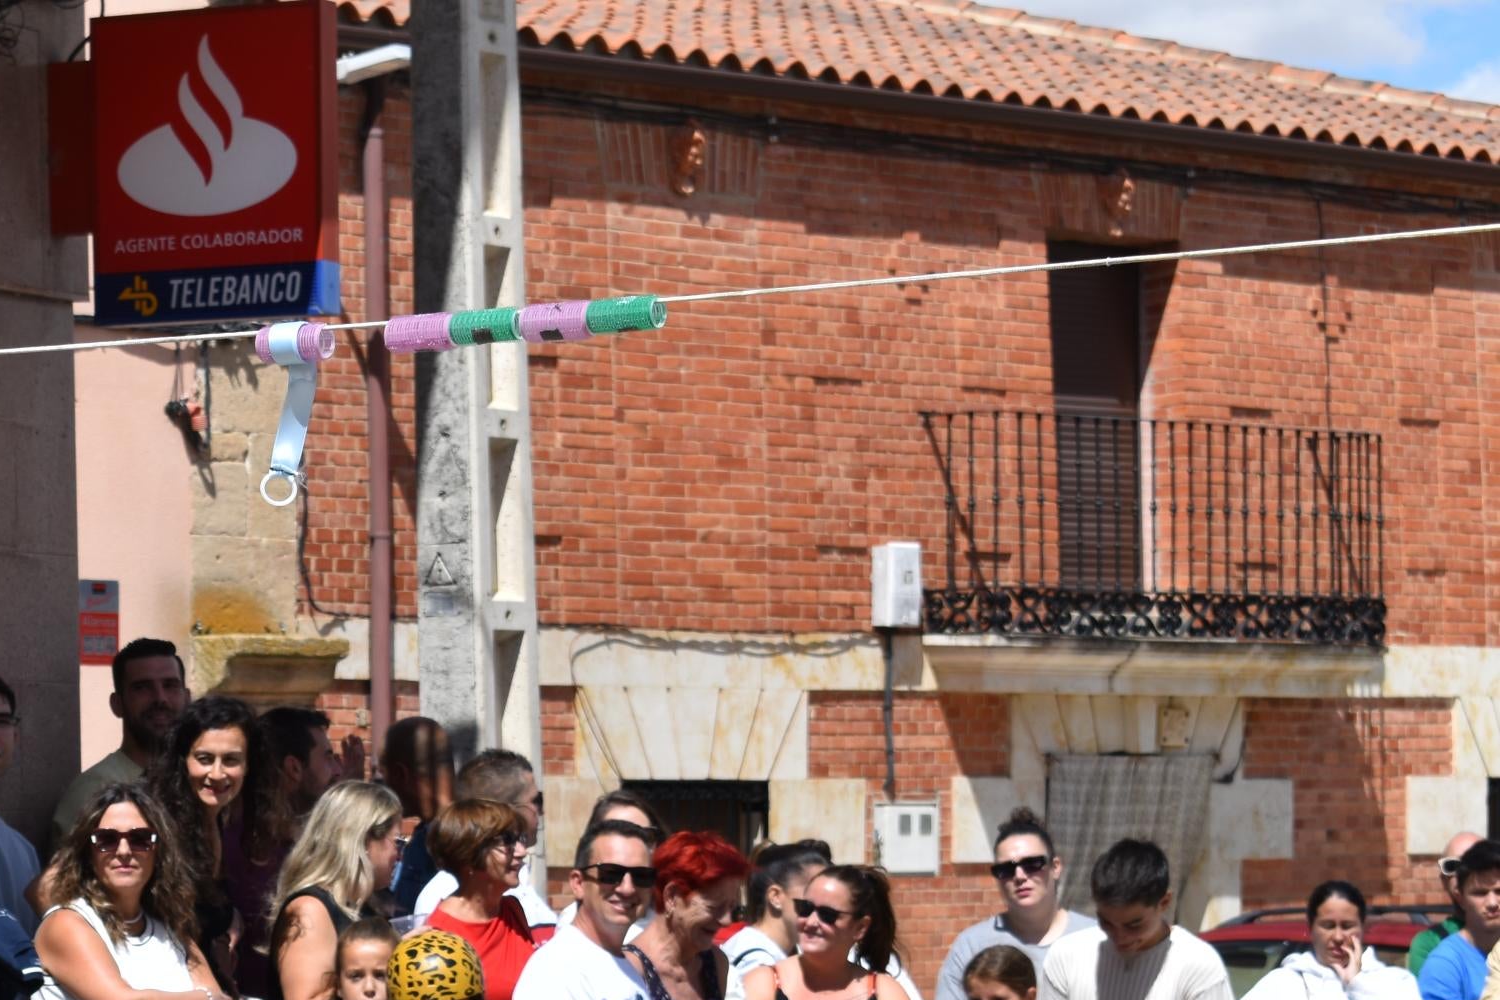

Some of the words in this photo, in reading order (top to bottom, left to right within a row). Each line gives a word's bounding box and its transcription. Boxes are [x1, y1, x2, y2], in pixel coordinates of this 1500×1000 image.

[114, 236, 176, 255] AGENTE
[181, 228, 303, 250] COLABORADOR
[169, 271, 301, 309] TELEBANCO
